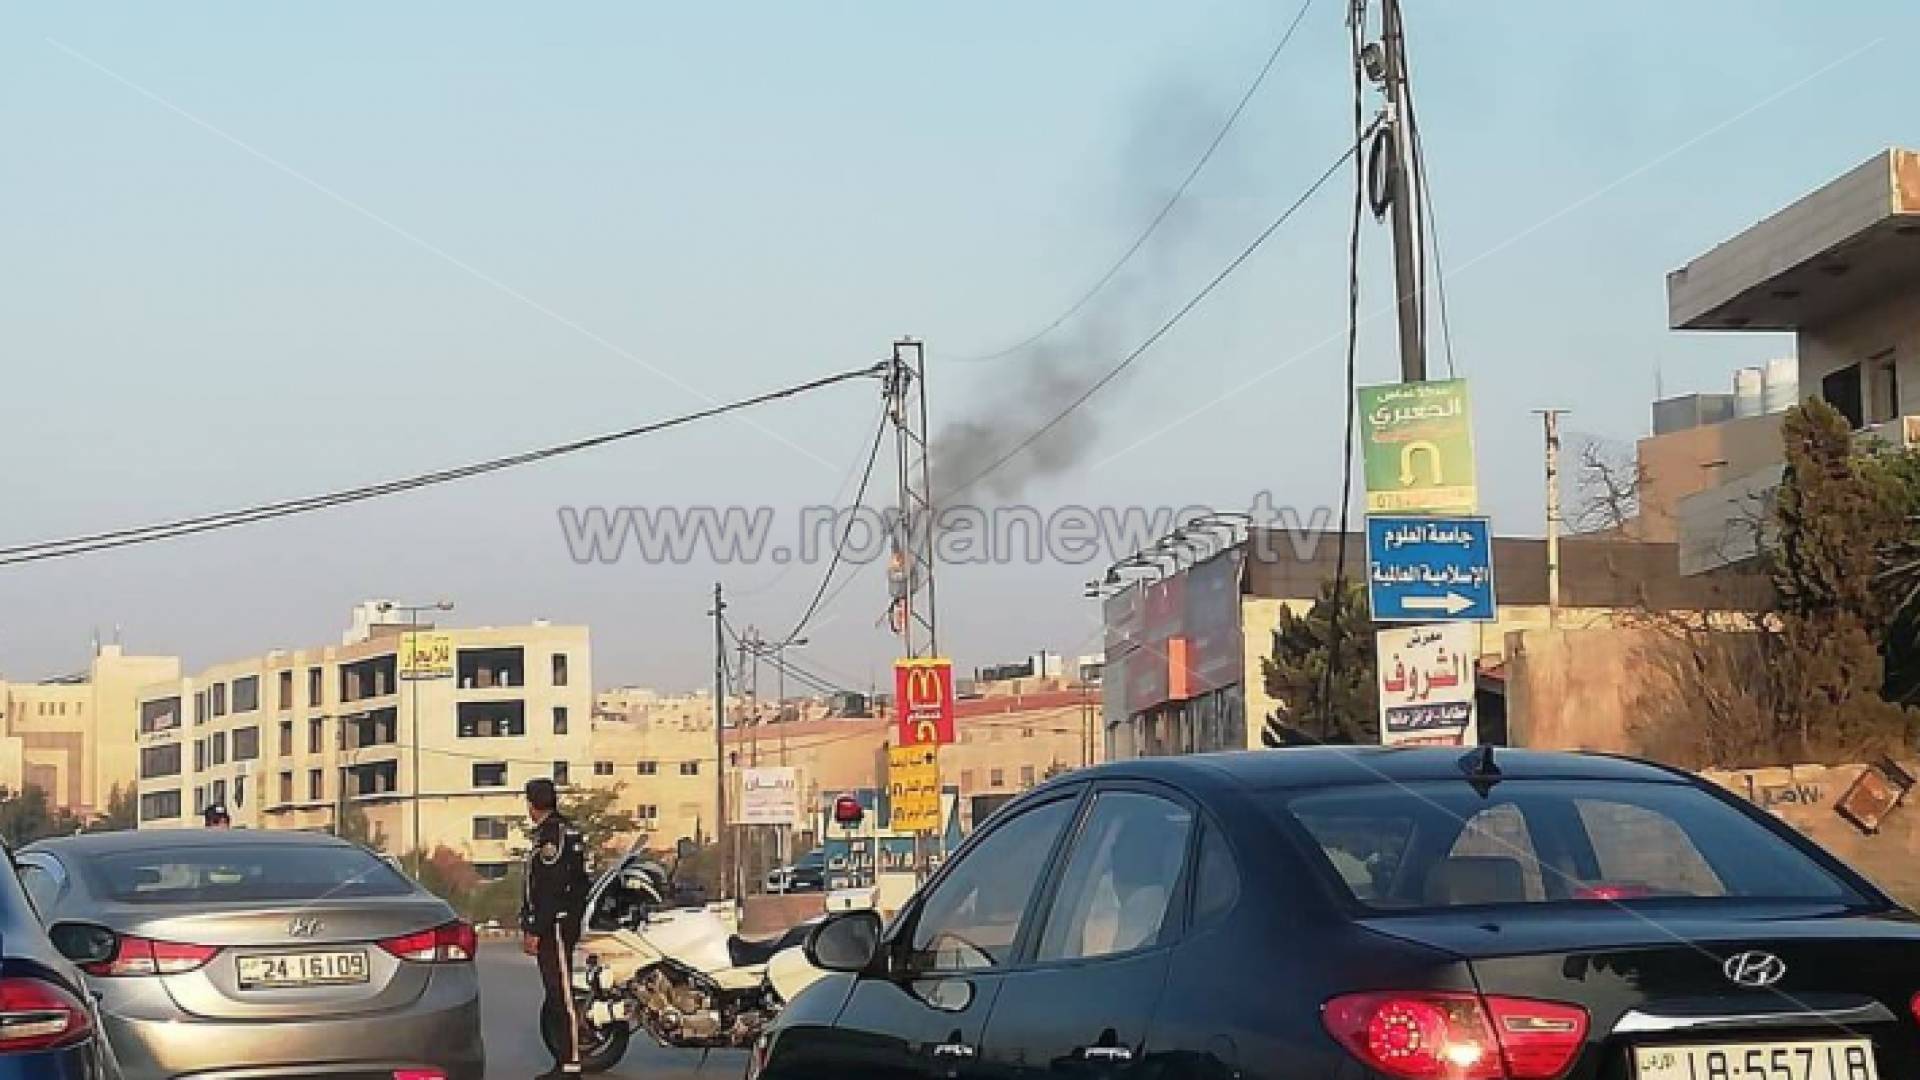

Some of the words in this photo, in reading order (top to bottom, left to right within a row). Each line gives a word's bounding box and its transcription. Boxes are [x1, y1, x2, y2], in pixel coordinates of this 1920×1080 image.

[1384, 523, 1427, 552] العلوم
[1426, 523, 1475, 549] جامعة
[1370, 561, 1421, 587] العالمية
[1406, 628, 1443, 650] معرض
